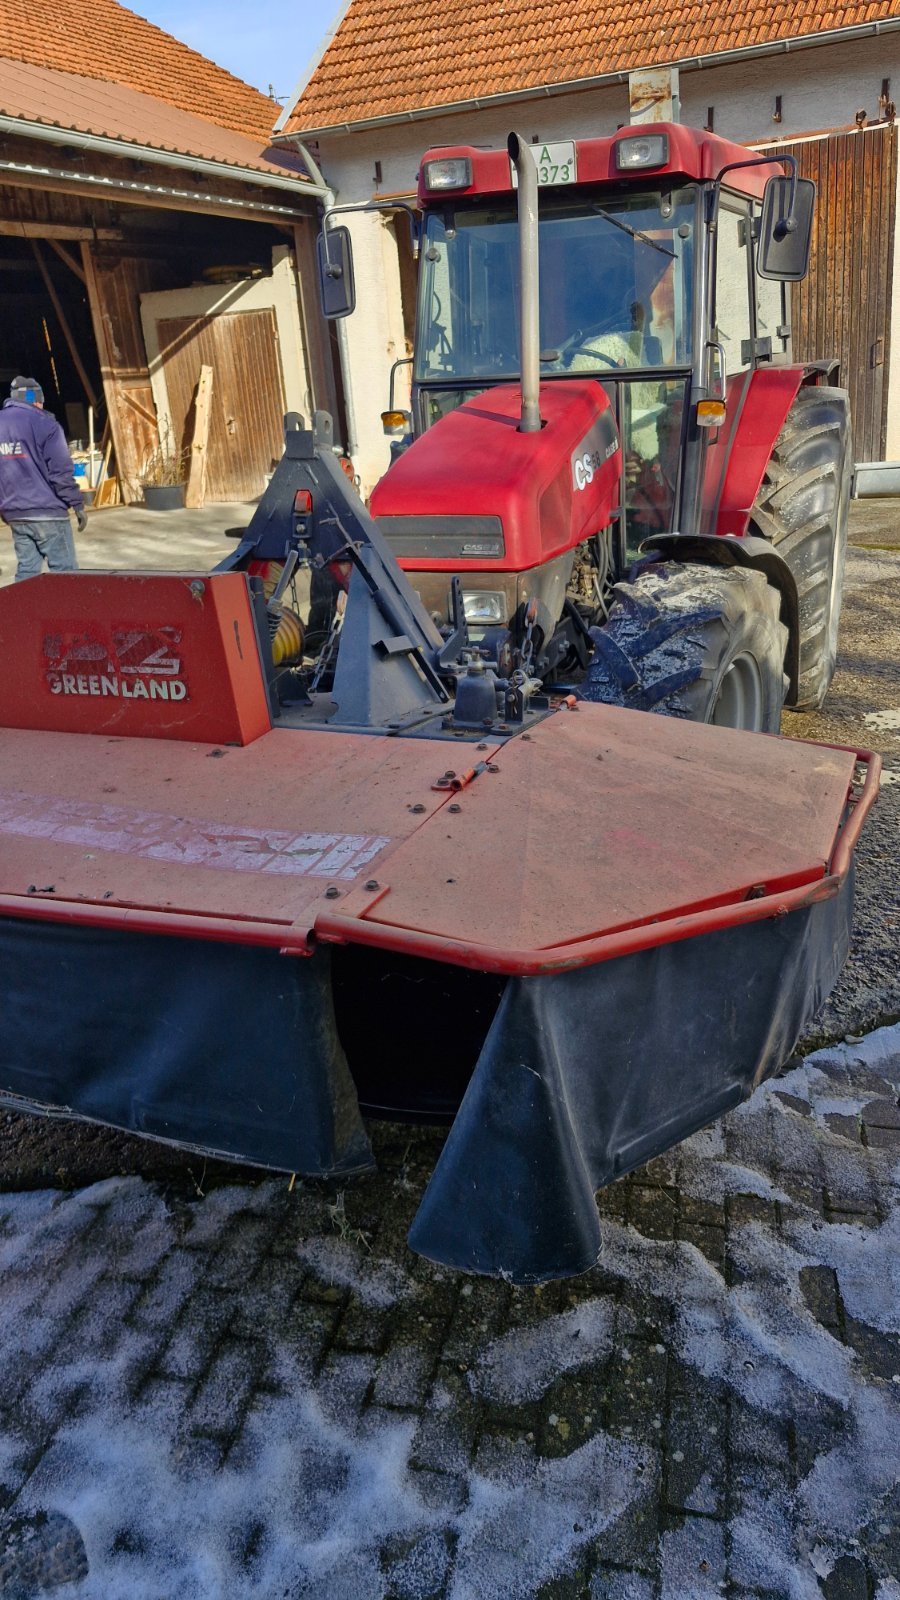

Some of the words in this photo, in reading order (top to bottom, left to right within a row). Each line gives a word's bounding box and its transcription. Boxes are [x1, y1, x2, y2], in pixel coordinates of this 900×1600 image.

[539, 145, 552, 164] A
[575, 452, 594, 491] CS
[46, 672, 187, 701] GREENLAND
